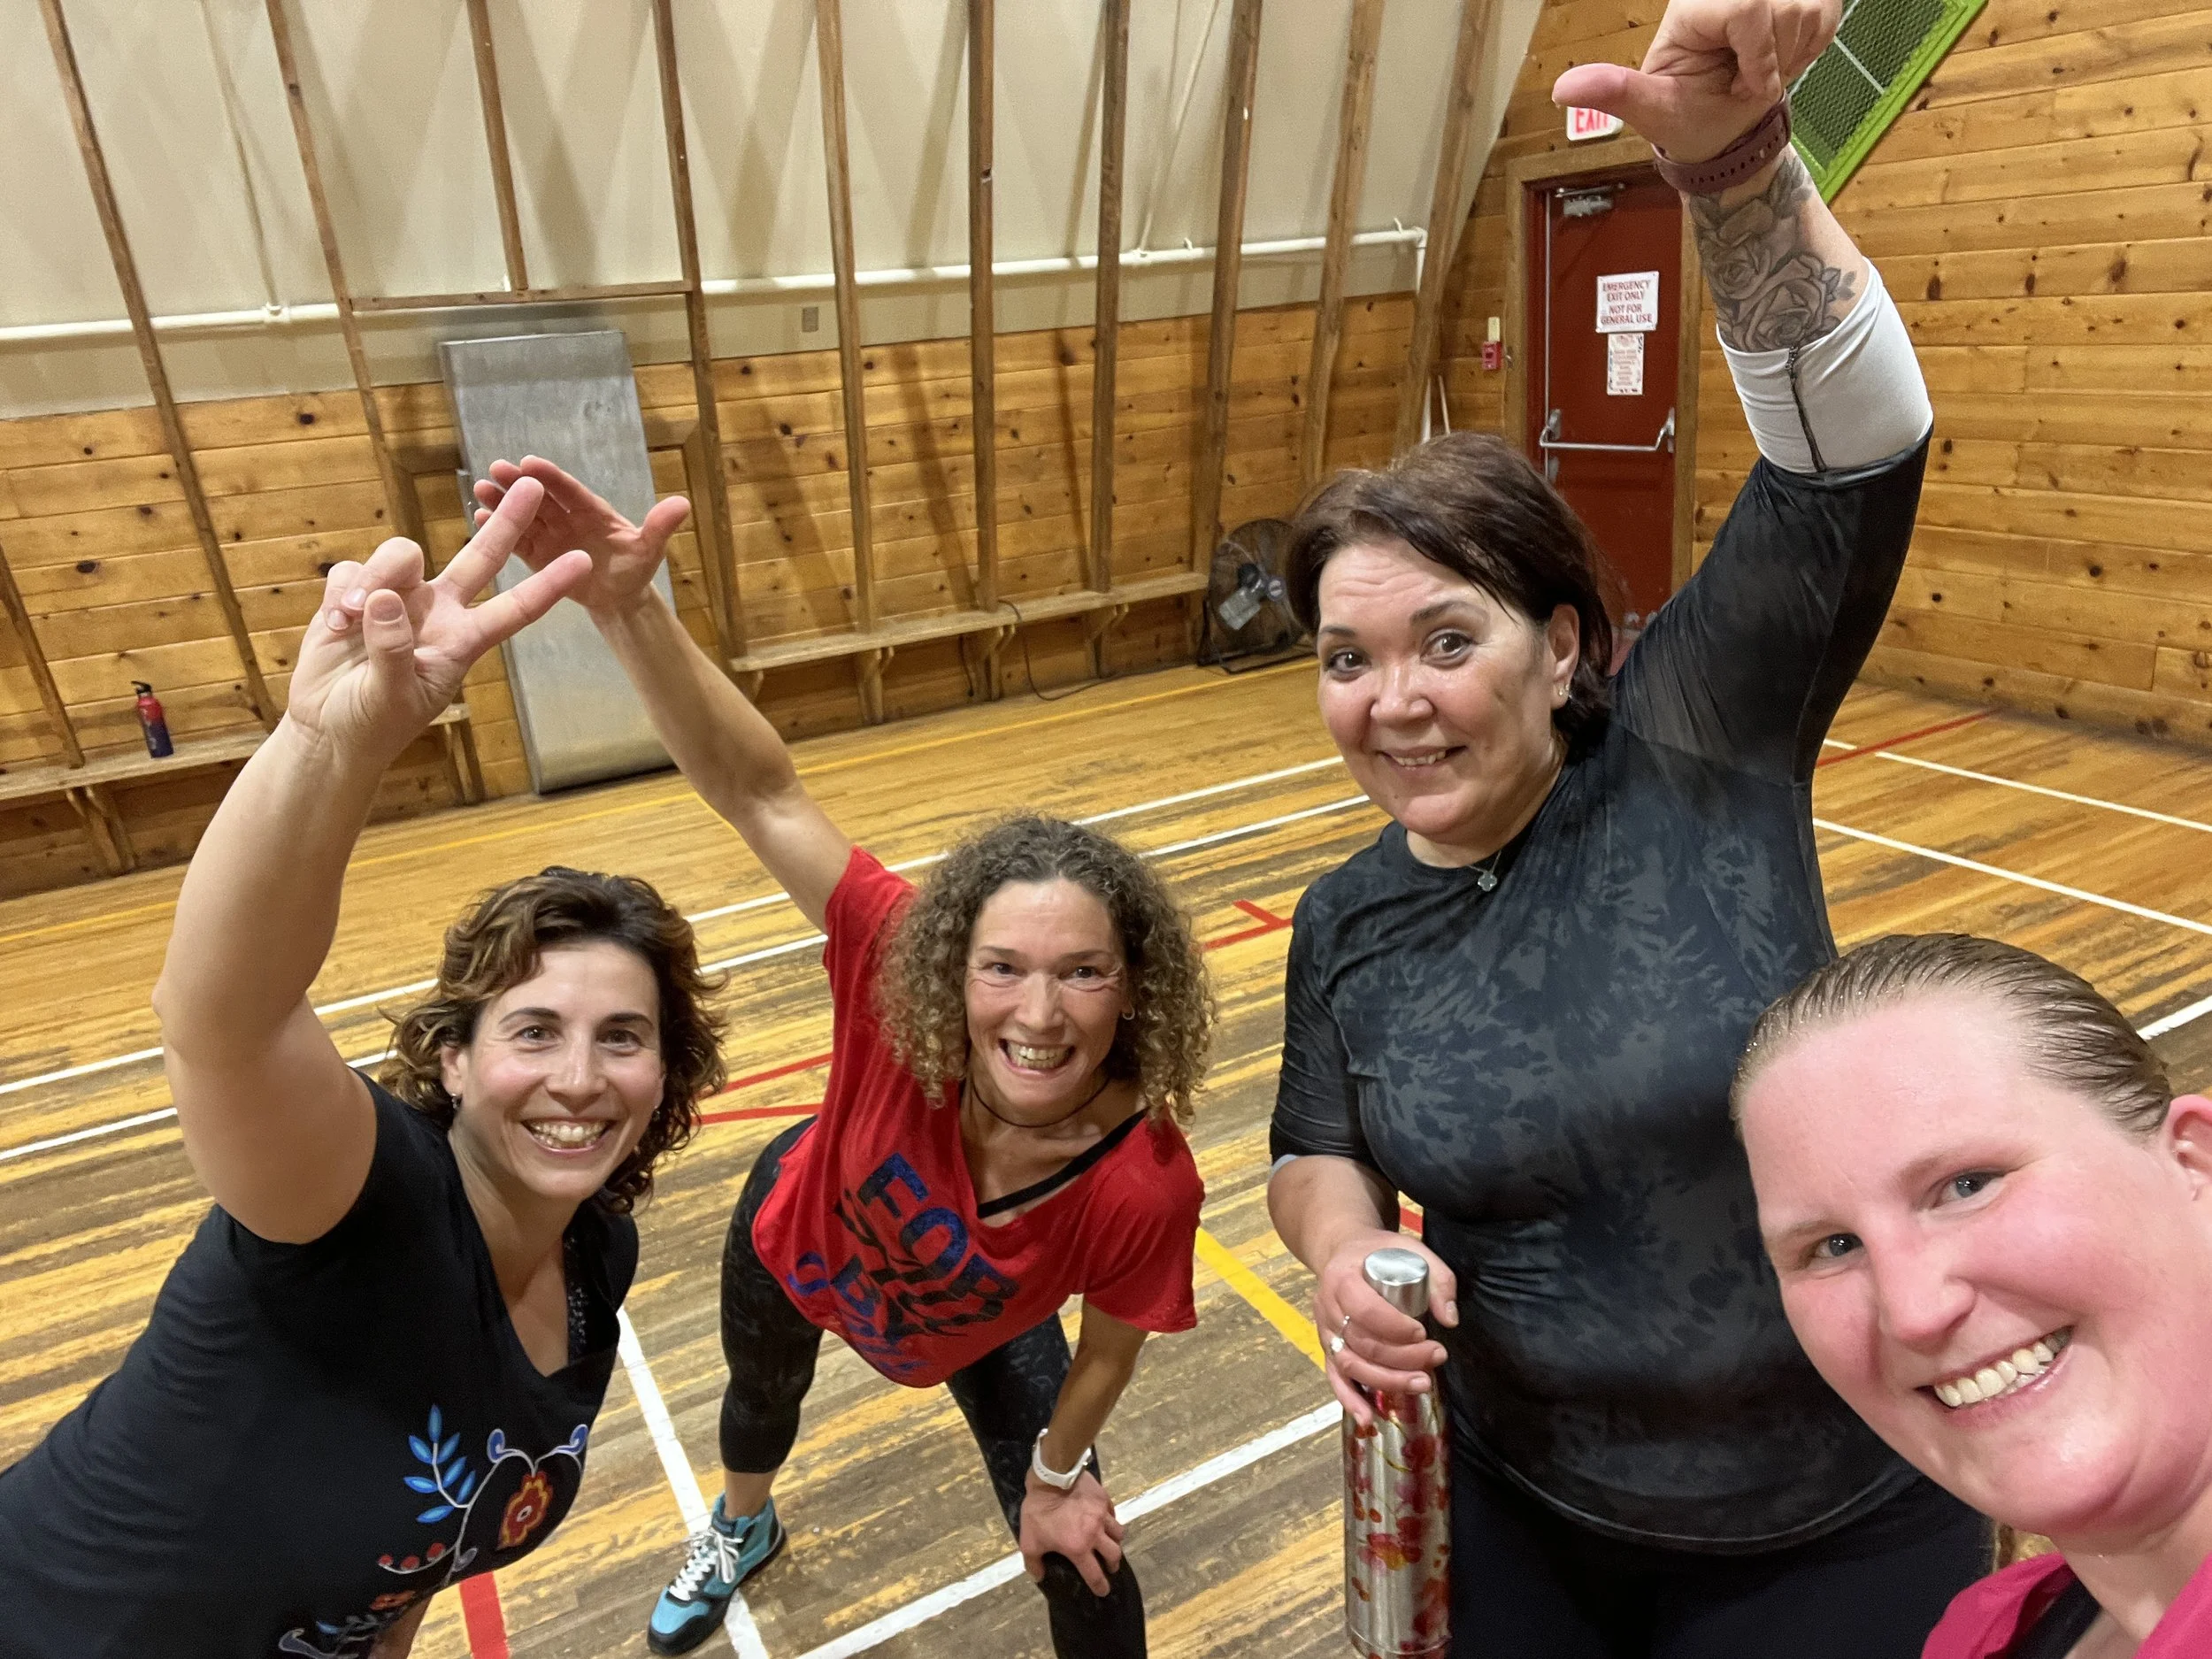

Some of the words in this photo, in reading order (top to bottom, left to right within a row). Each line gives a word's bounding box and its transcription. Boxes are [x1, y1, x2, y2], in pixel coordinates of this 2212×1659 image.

[1602, 280, 1650, 292] EMERGENCY
[1607, 291, 1623, 302] EXIT
[1624, 290, 1644, 301] ONLY
[1609, 304, 1624, 314] NOT
[1626, 303, 1642, 313] FOR
[1601, 314, 1634, 325] GENERAL
[1636, 313, 1653, 324] USE
